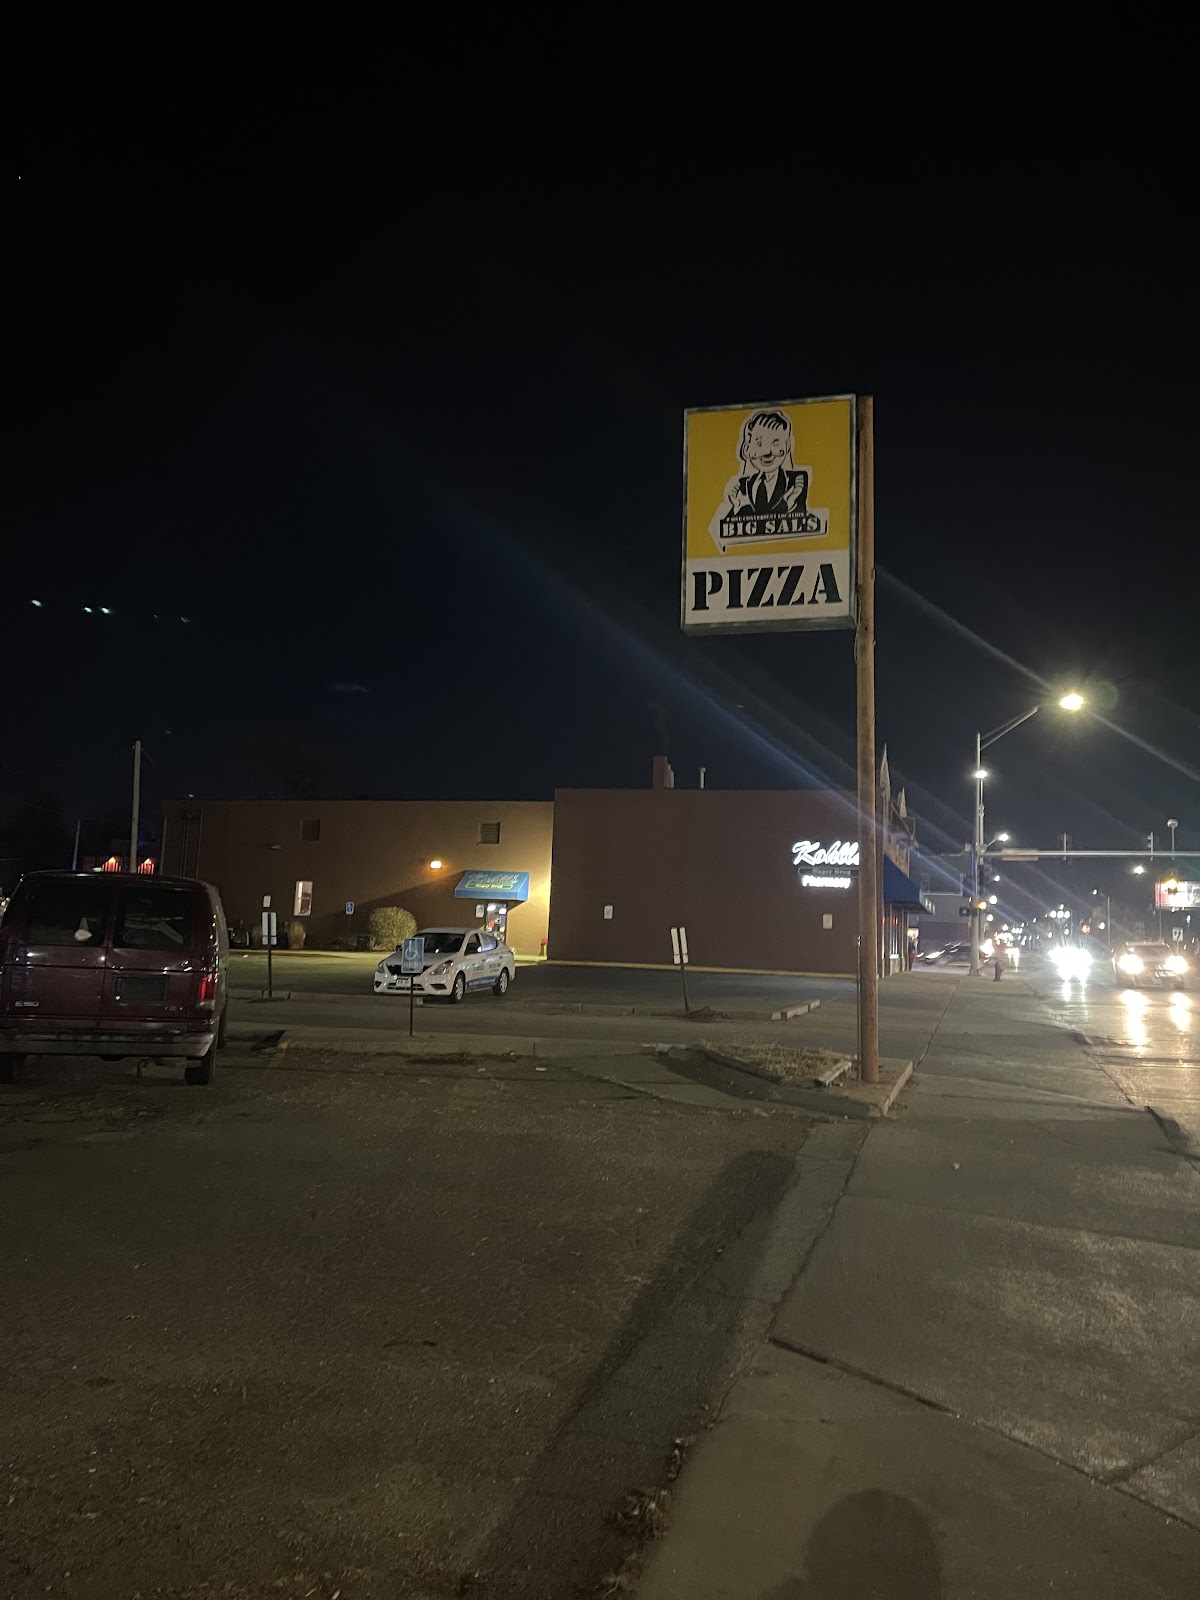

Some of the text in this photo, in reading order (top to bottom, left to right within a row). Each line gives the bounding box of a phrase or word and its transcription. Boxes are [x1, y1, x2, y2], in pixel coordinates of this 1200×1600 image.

[722, 516, 818, 537] BIG SAL'S
[692, 563, 843, 611] PIZZA
[802, 875, 851, 889] Pharmacy
